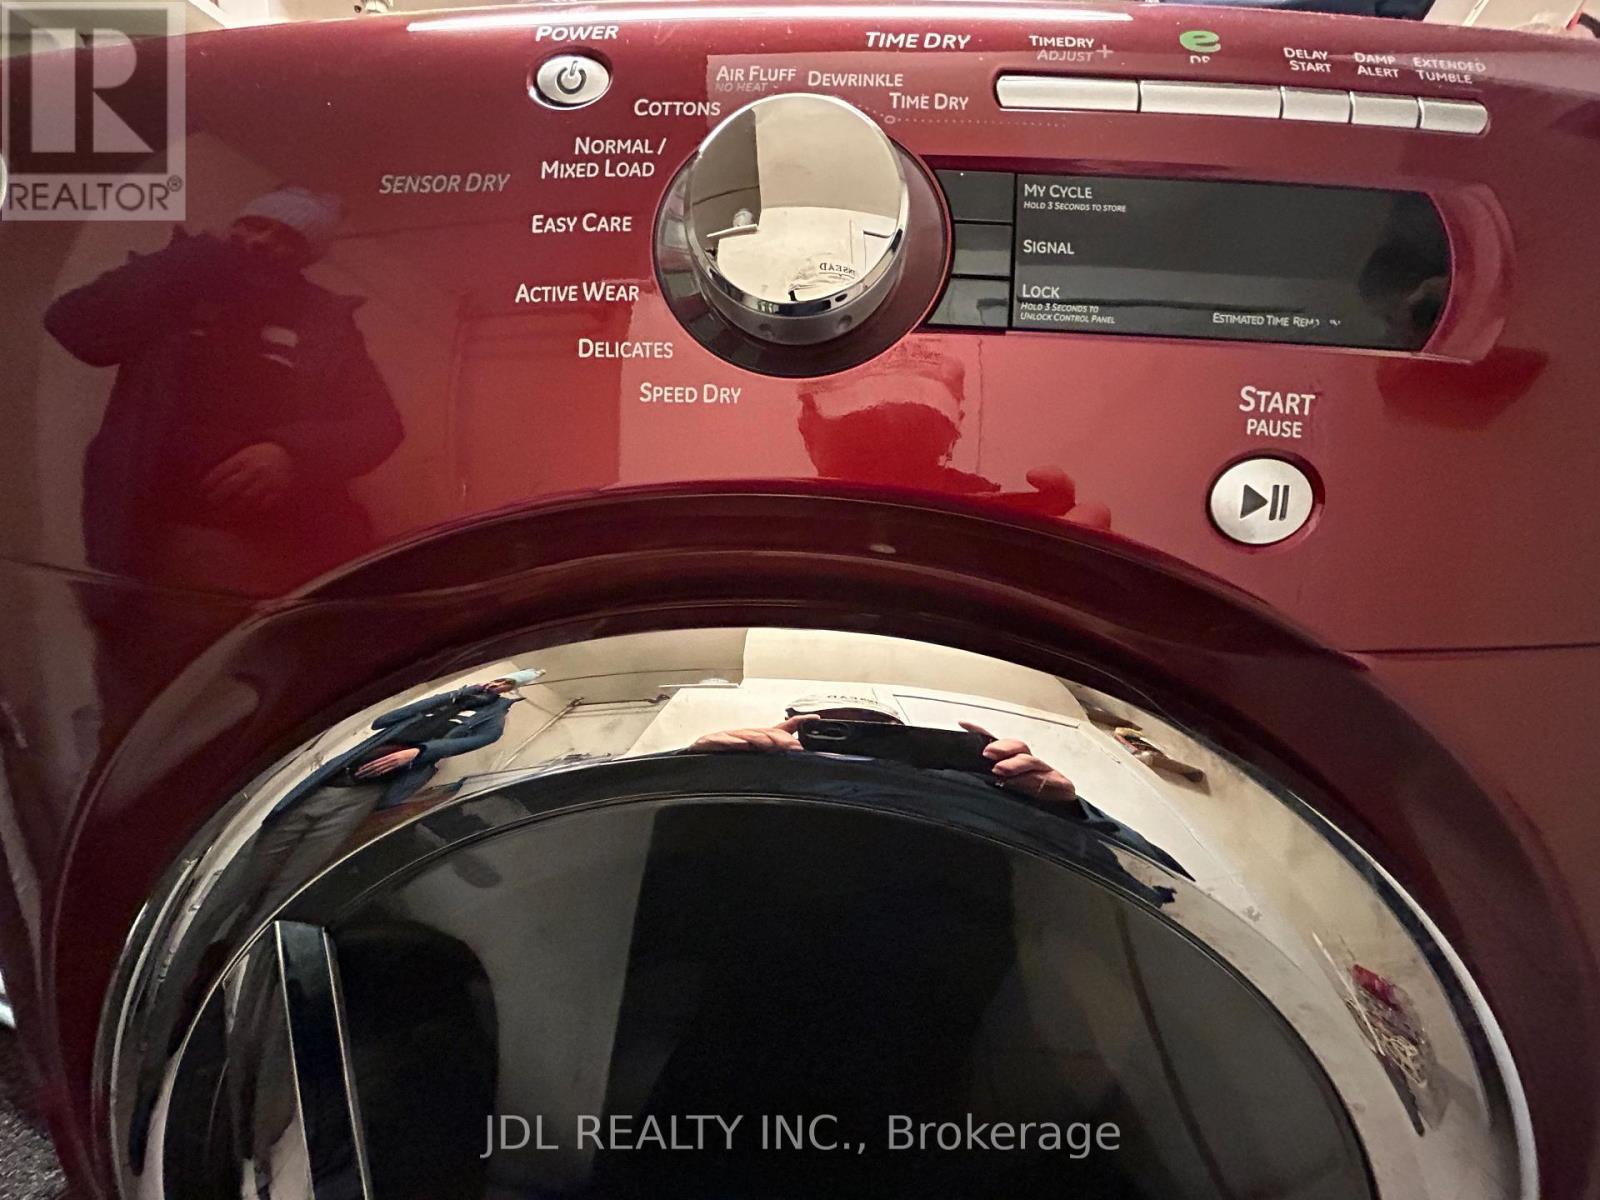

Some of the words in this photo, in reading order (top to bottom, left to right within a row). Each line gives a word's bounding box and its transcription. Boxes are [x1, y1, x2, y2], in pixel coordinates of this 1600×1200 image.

[535, 25, 620, 42] POWER
[866, 31, 919, 48] TIME
[923, 33, 971, 50] DRY
[1029, 35, 1095, 48] TIMEDRY
[1037, 49, 1094, 62] ADJUST
[1283, 47, 1328, 61] DELAY
[1353, 52, 1396, 65] DAMP
[1289, 60, 1332, 73] START
[1357, 65, 1400, 78] ALERT
[1412, 56, 1486, 73] EXTENDED
[716, 65, 744, 81] AIR
[749, 65, 797, 81] FLUFF
[807, 70, 904, 87] DEWRINKLE
[1416, 69, 1473, 84] TUMBLE
[715, 82, 733, 92] NO
[736, 82, 769, 92] HEAT
[634, 98, 721, 116] COTTONS
[889, 92, 929, 109] TIME
[933, 93, 969, 111] DRY
[574, 136, 653, 155] NORMAL
[540, 160, 599, 179] MIXED
[604, 159, 655, 177] LOAD
[379, 174, 461, 194] SENSOR
[465, 172, 511, 192] DRY
[1023, 184, 1046, 197] MY
[1049, 184, 1093, 199] CYCLE
[1023, 201, 1046, 210] HOLD
[1047, 202, 1053, 210] 3
[1054, 202, 1090, 211] SECONDS
[1103, 204, 1127, 213] STORE
[531, 214, 577, 233] EASY
[582, 212, 632, 232] CARE
[1023, 239, 1075, 255] SIGNAL
[515, 283, 578, 303] ACTIVE
[582, 282, 640, 301] WEAR
[1022, 284, 1060, 299] LOCK
[1020, 302, 1043, 311] HOLD
[1044, 303, 1051, 311] 3
[1051, 303, 1087, 313] SECONDS
[1089, 305, 1099, 313] TO
[1020, 312, 1052, 321] UNLOCK
[1053, 313, 1090, 323] CONTROL
[1091, 315, 1116, 324] PANEL
[1212, 312, 1265, 325] ESTIMATED
[1266, 314, 1290, 327] TIME
[578, 338, 674, 359] DELICATES
[639, 382, 699, 403] SPEED
[702, 384, 742, 404] DRY
[1239, 385, 1317, 416] START
[1246, 418, 1304, 438] PAUSE
